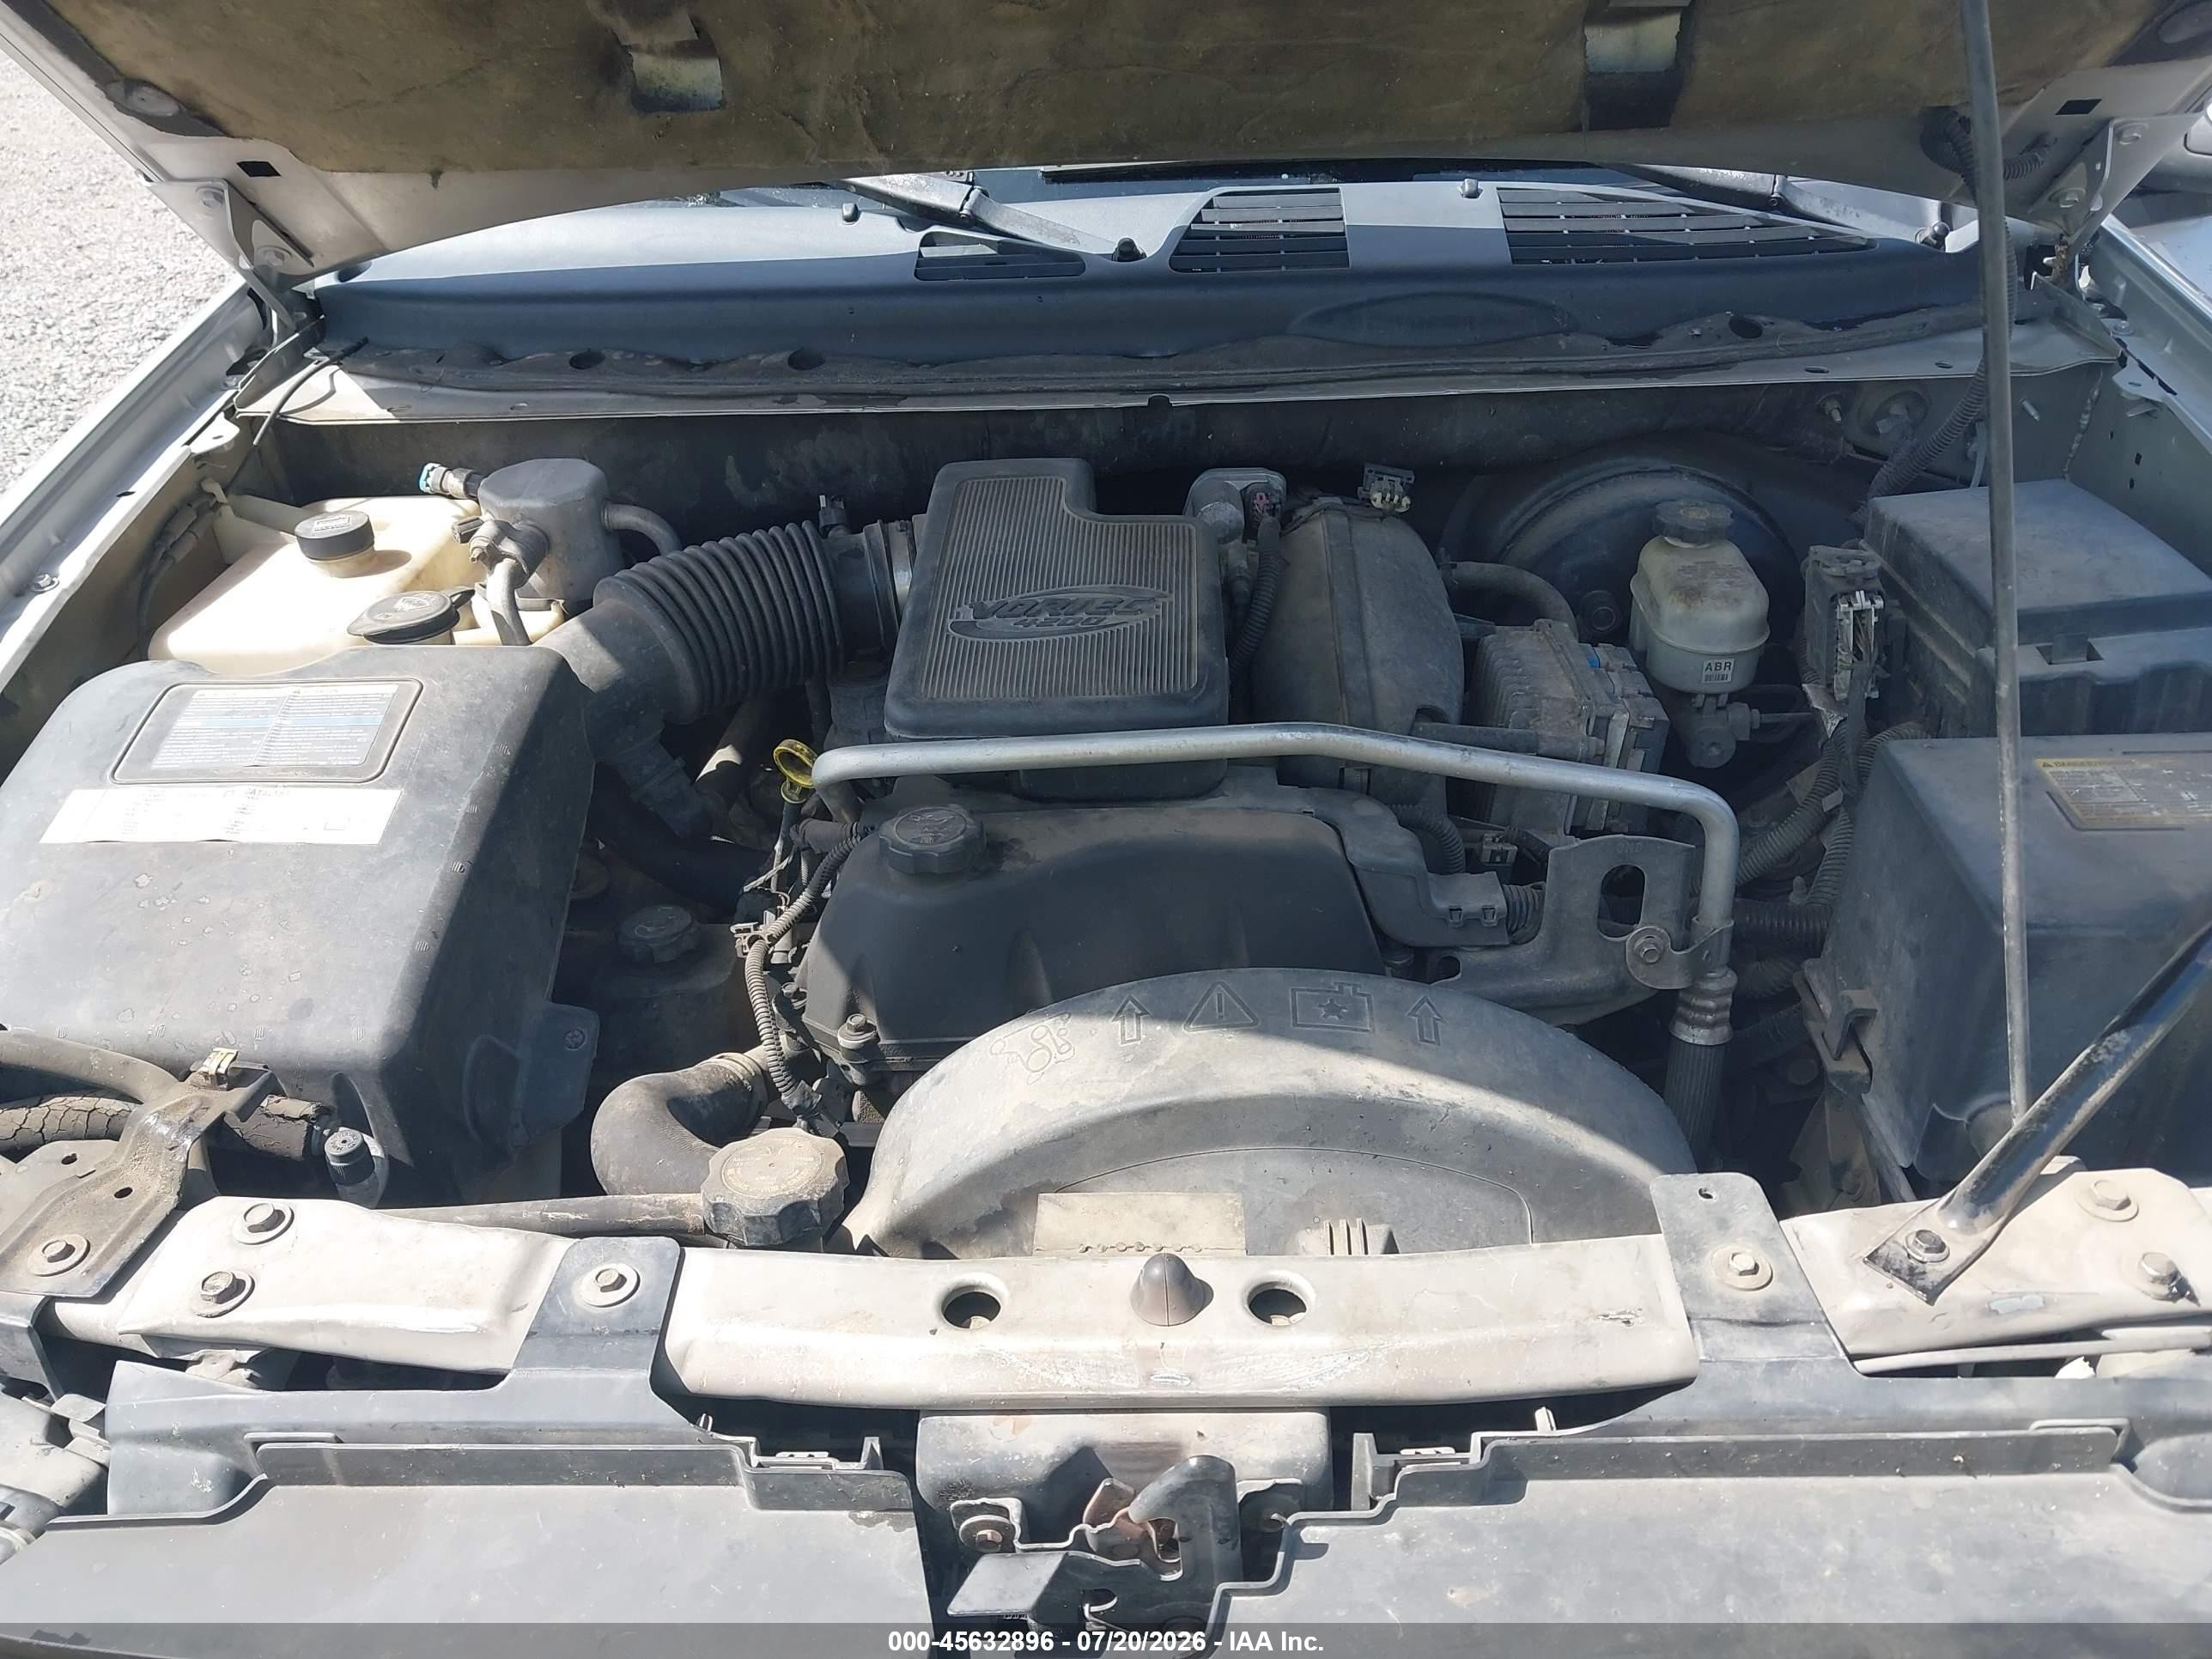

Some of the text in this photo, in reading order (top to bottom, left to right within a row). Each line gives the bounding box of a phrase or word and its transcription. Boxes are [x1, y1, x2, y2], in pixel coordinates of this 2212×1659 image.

[971, 598, 1157, 619] VORTEC
[1012, 617, 1108, 629] 4200
[1705, 661, 1732, 672] ABR
